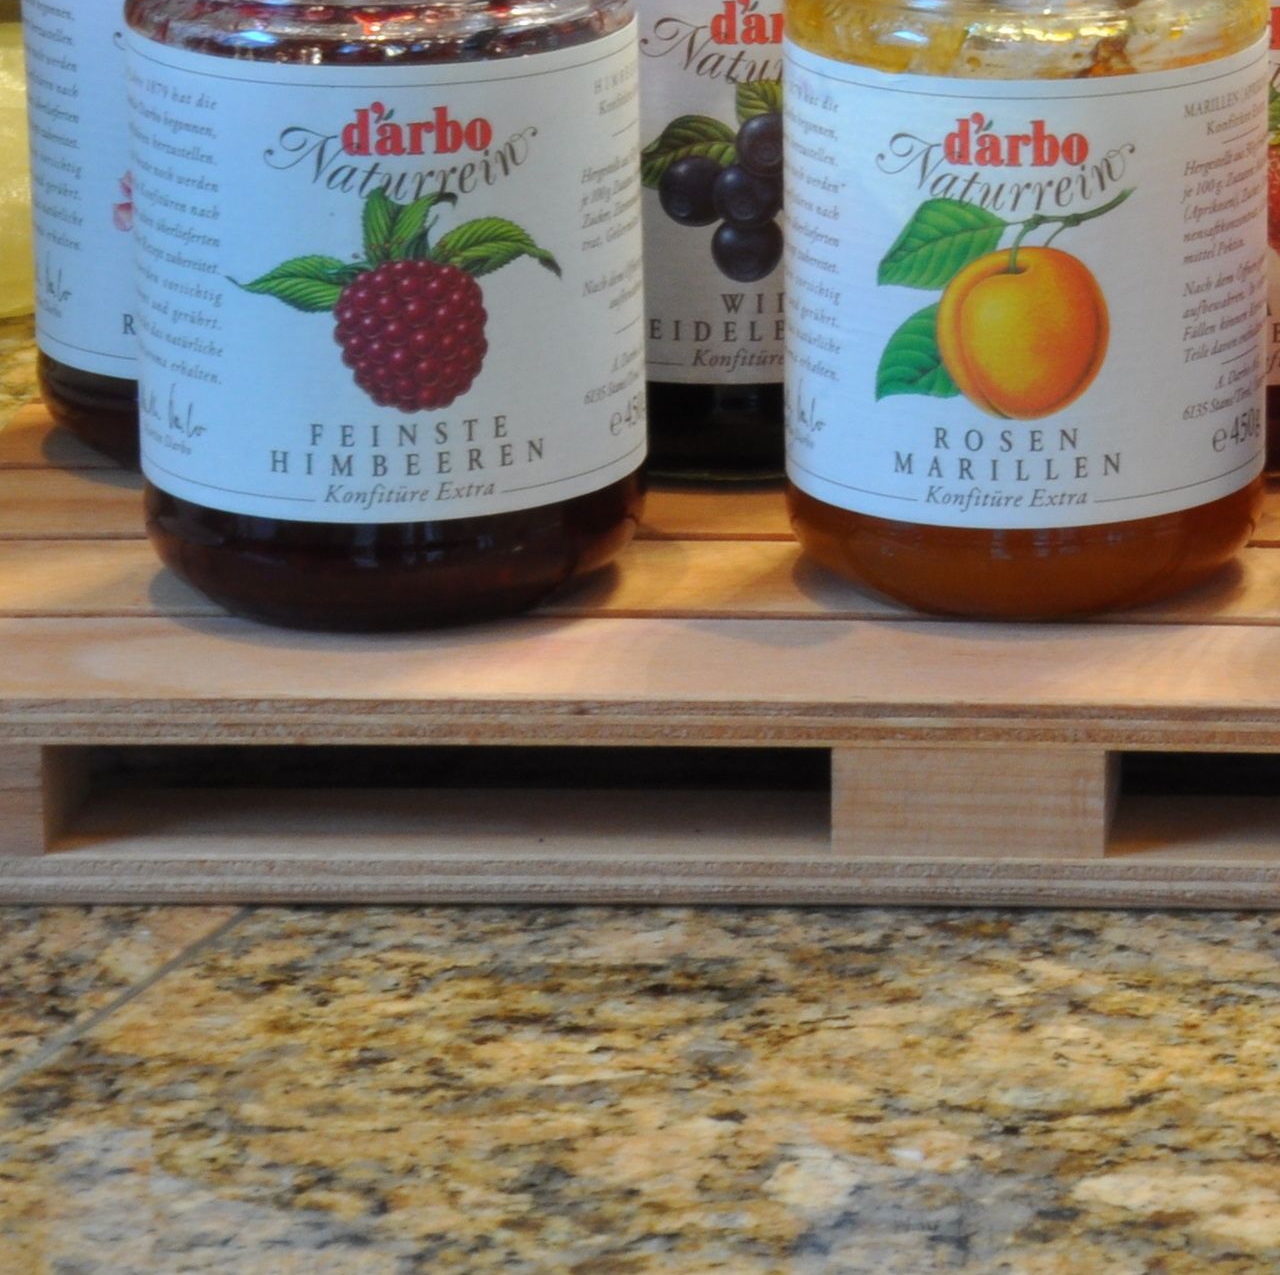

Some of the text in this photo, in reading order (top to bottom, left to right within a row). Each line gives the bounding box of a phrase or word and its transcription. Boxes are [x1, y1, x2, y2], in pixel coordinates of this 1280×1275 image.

[263, 126, 538, 202] Naturrein
[876, 132, 1135, 212] Naturrein
[649, 319, 785, 342] EIDELE
[310, 415, 508, 447] FEINSTE
[934, 427, 1078, 452] ROSEN
[270, 437, 544, 477] HIMBEEREN
[893, 452, 1120, 481] MARILLEN
[324, 481, 495, 510] Konfitüre Extra
[925, 485, 1089, 513] Konfitüre Extra
